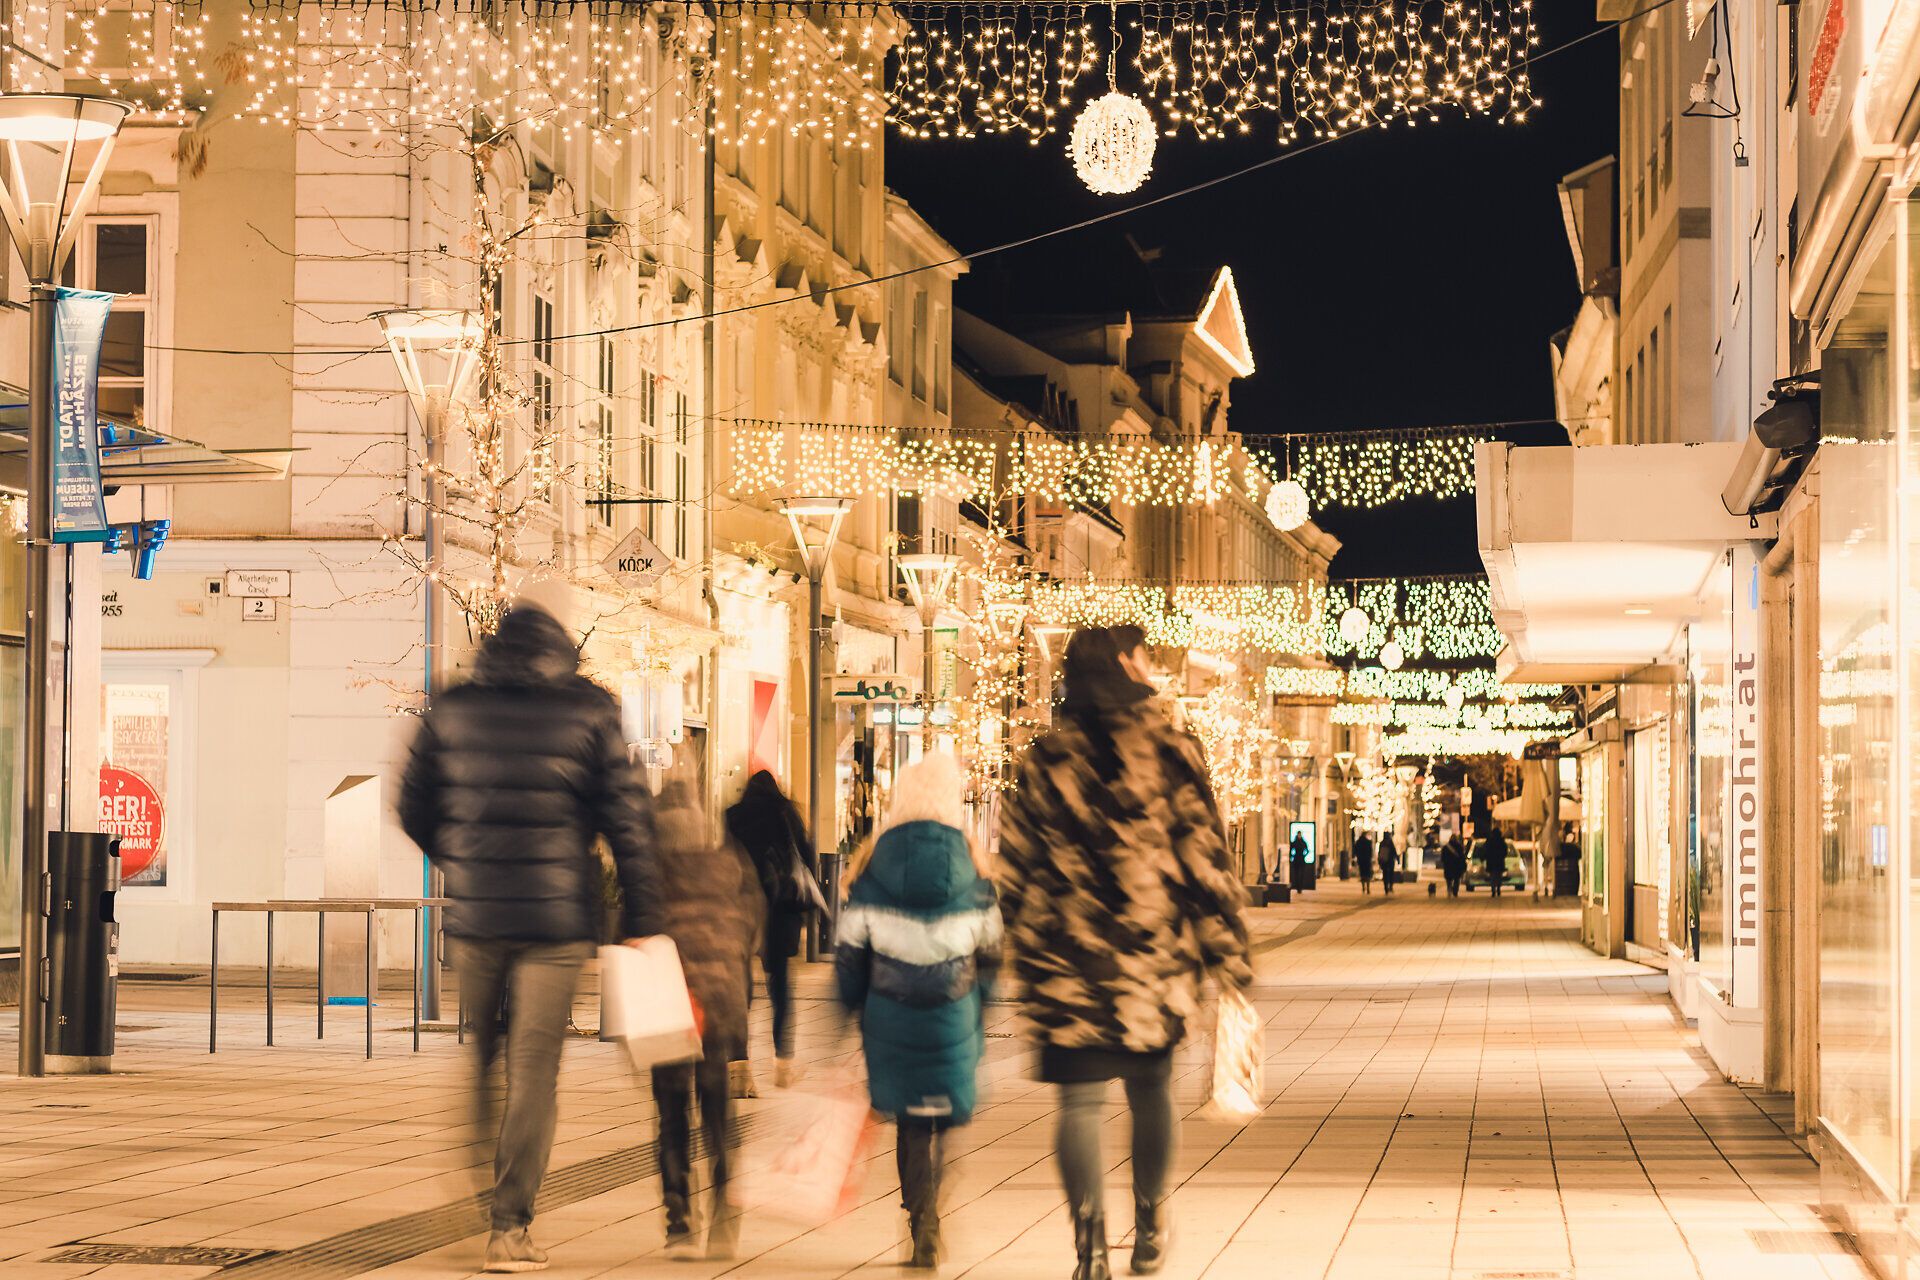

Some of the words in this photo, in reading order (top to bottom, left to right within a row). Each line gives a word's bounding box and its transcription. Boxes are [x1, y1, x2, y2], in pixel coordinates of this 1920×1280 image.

[618, 556, 653, 572] KÖCK
[101, 590, 117, 602] seit
[101, 605, 123, 617] 955
[254, 600, 264, 612] 2
[1733, 652, 1756, 947] immohr.at
[98, 795, 146, 821] GER!
